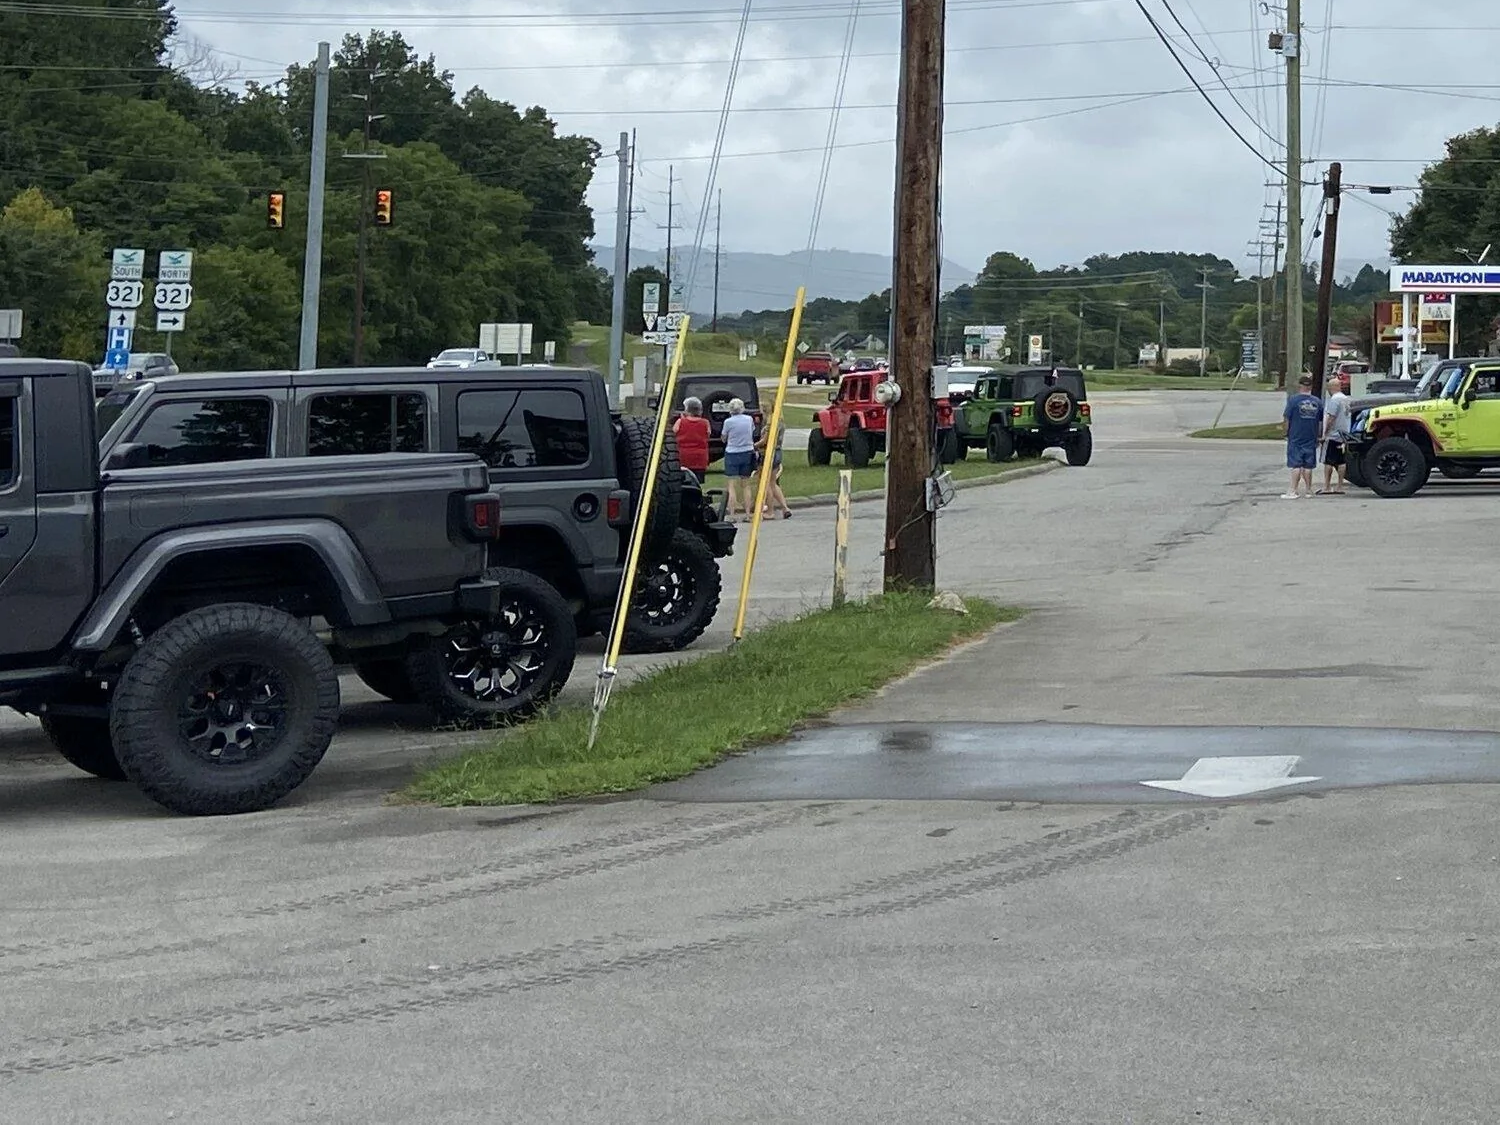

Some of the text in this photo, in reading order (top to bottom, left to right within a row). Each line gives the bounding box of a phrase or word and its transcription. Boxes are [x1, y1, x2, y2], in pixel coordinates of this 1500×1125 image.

[113, 267, 141, 276] SOUTH
[160, 270, 189, 279] NORTH
[1401, 271, 1483, 284] MARATHON
[108, 286, 141, 302] 321
[156, 288, 190, 304] 321
[111, 329, 129, 349] H
